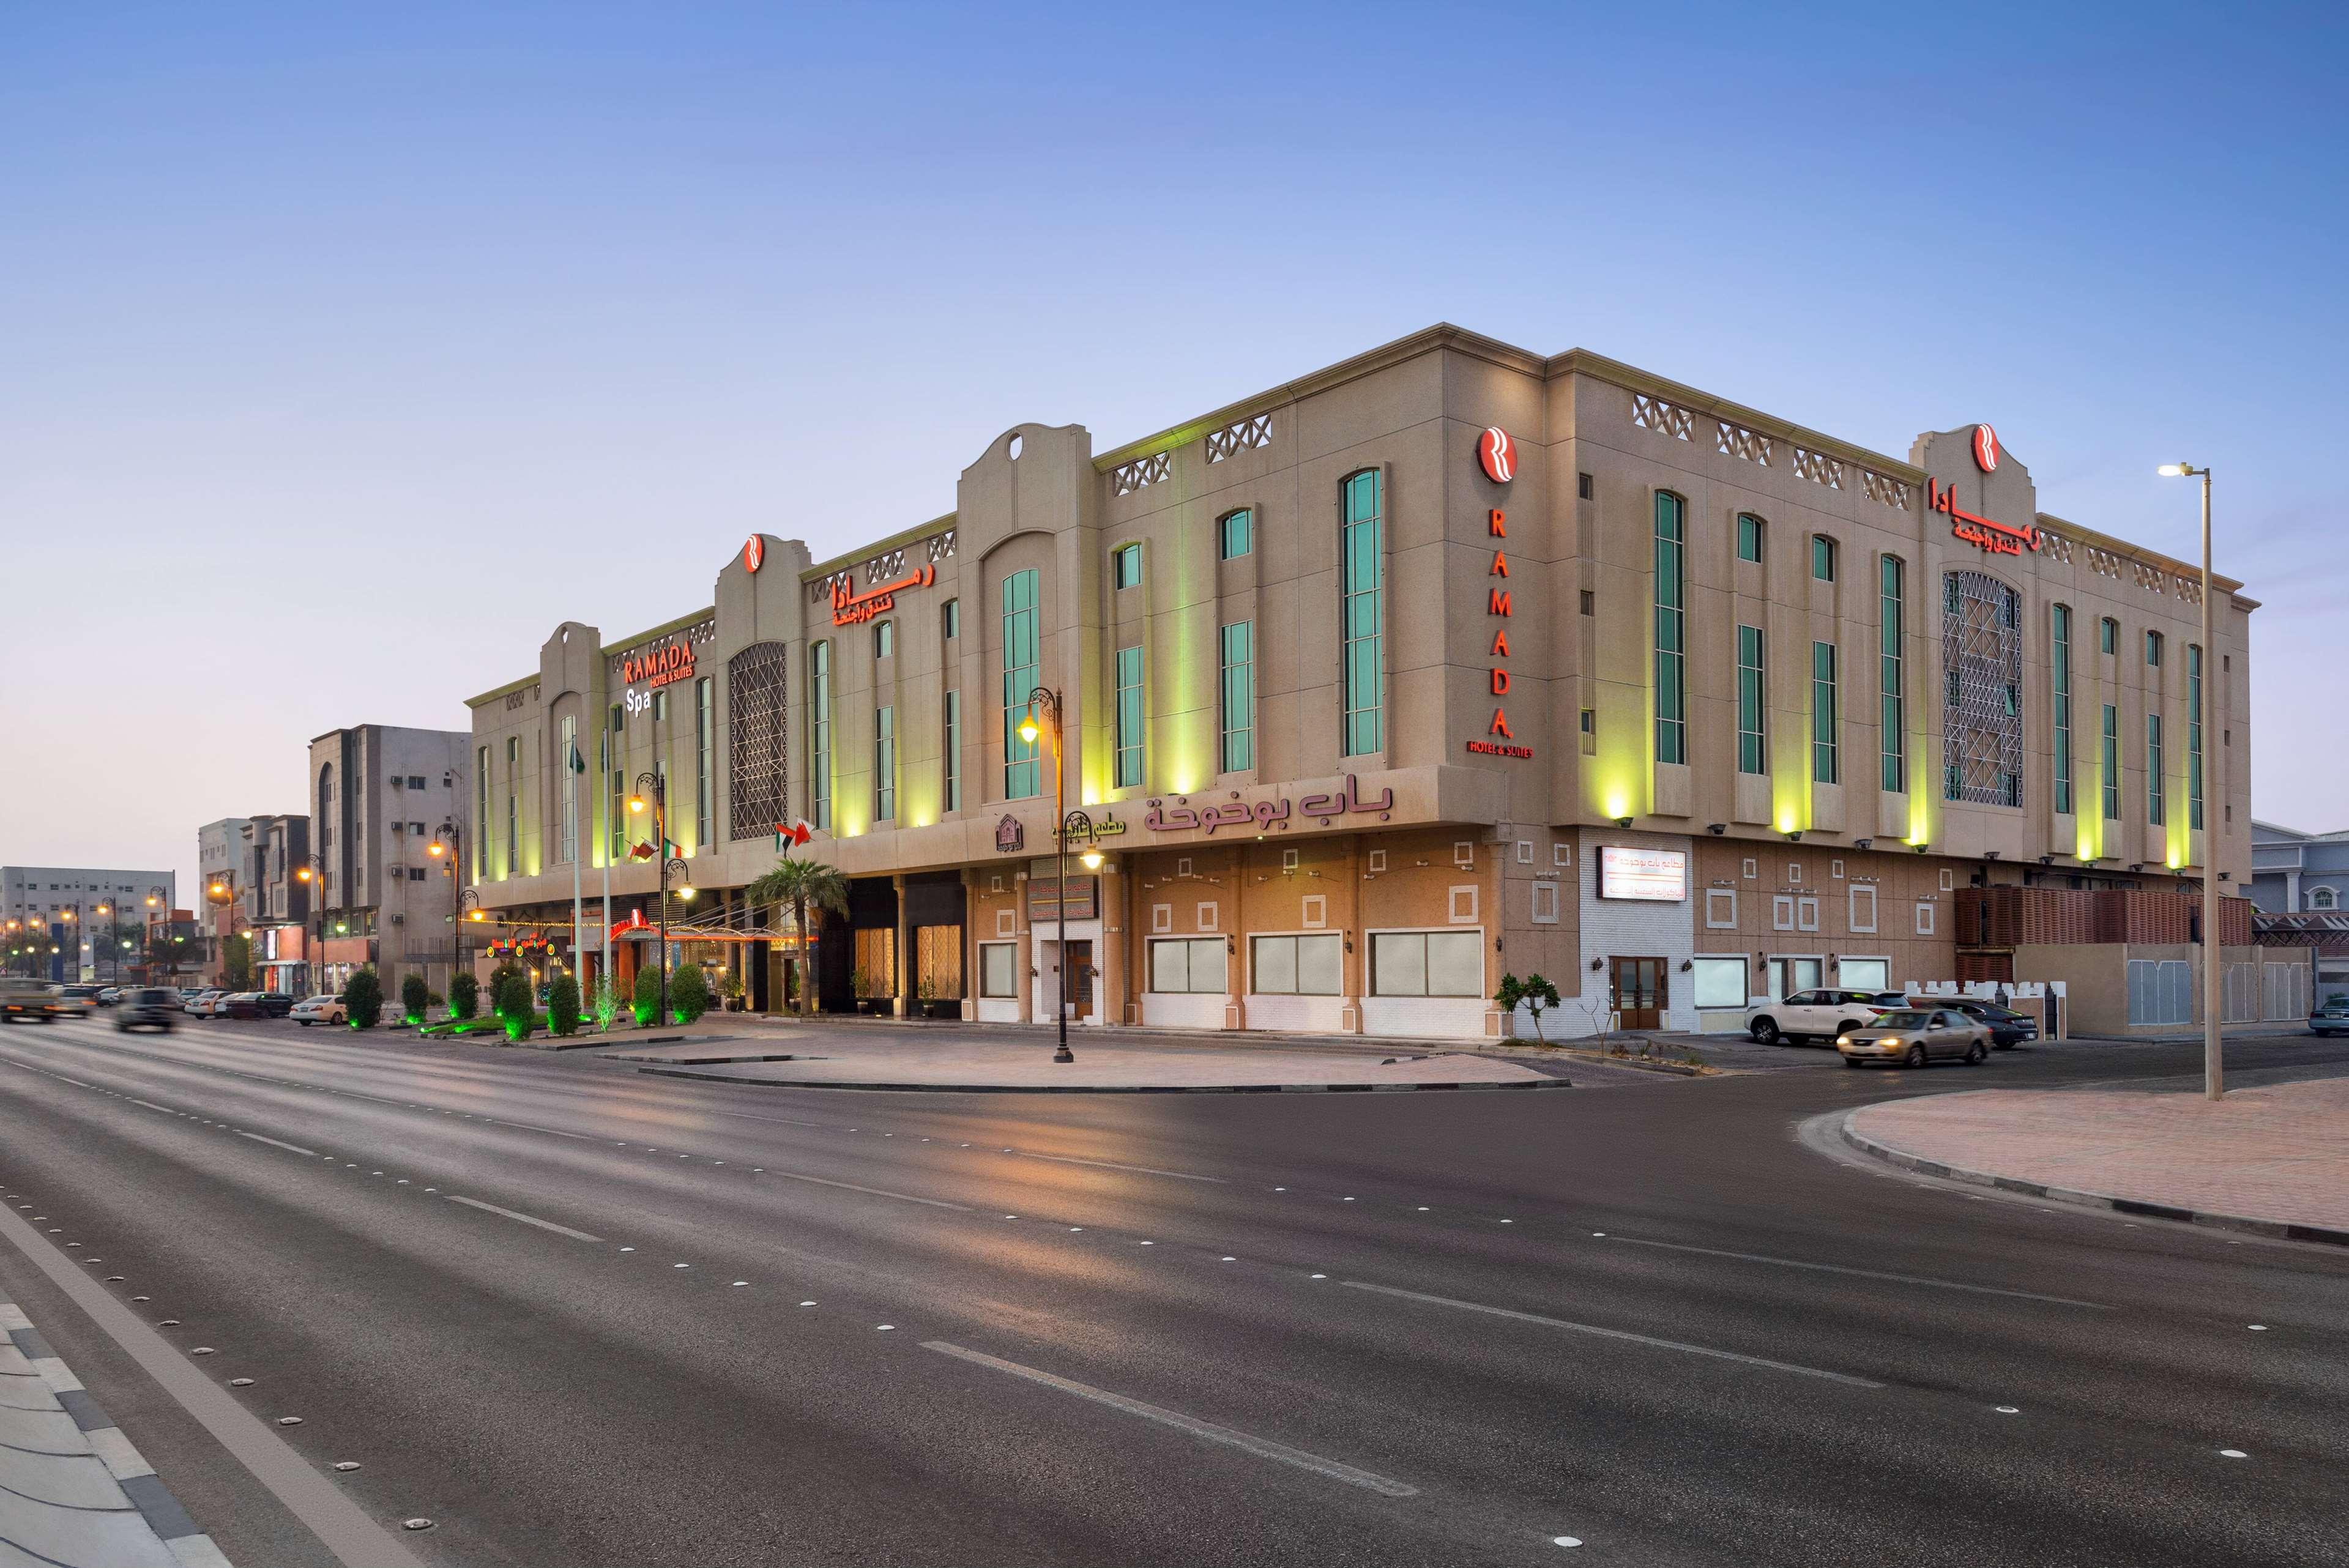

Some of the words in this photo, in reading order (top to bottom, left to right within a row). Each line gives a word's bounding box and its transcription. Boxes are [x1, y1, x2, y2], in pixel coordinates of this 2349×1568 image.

[1929, 477, 2041, 551] رمادا
[1992, 532, 2021, 556] فندق
[832, 563, 935, 611] رمادا
[866, 593, 894, 619] فندق
[650, 674, 668, 688] HOTEL
[668, 672, 673, 682] &
[674, 665, 693, 681] SUITES
[627, 688, 650, 718] Spa
[1468, 741, 1496, 754] HOTEL
[1497, 744, 1504, 755] &
[1507, 745, 1535, 758] SUITES
[1144, 791, 1290, 834] بوخوخة
[1298, 774, 1393, 826] باب
[1092, 812, 1126, 842] مطعم
